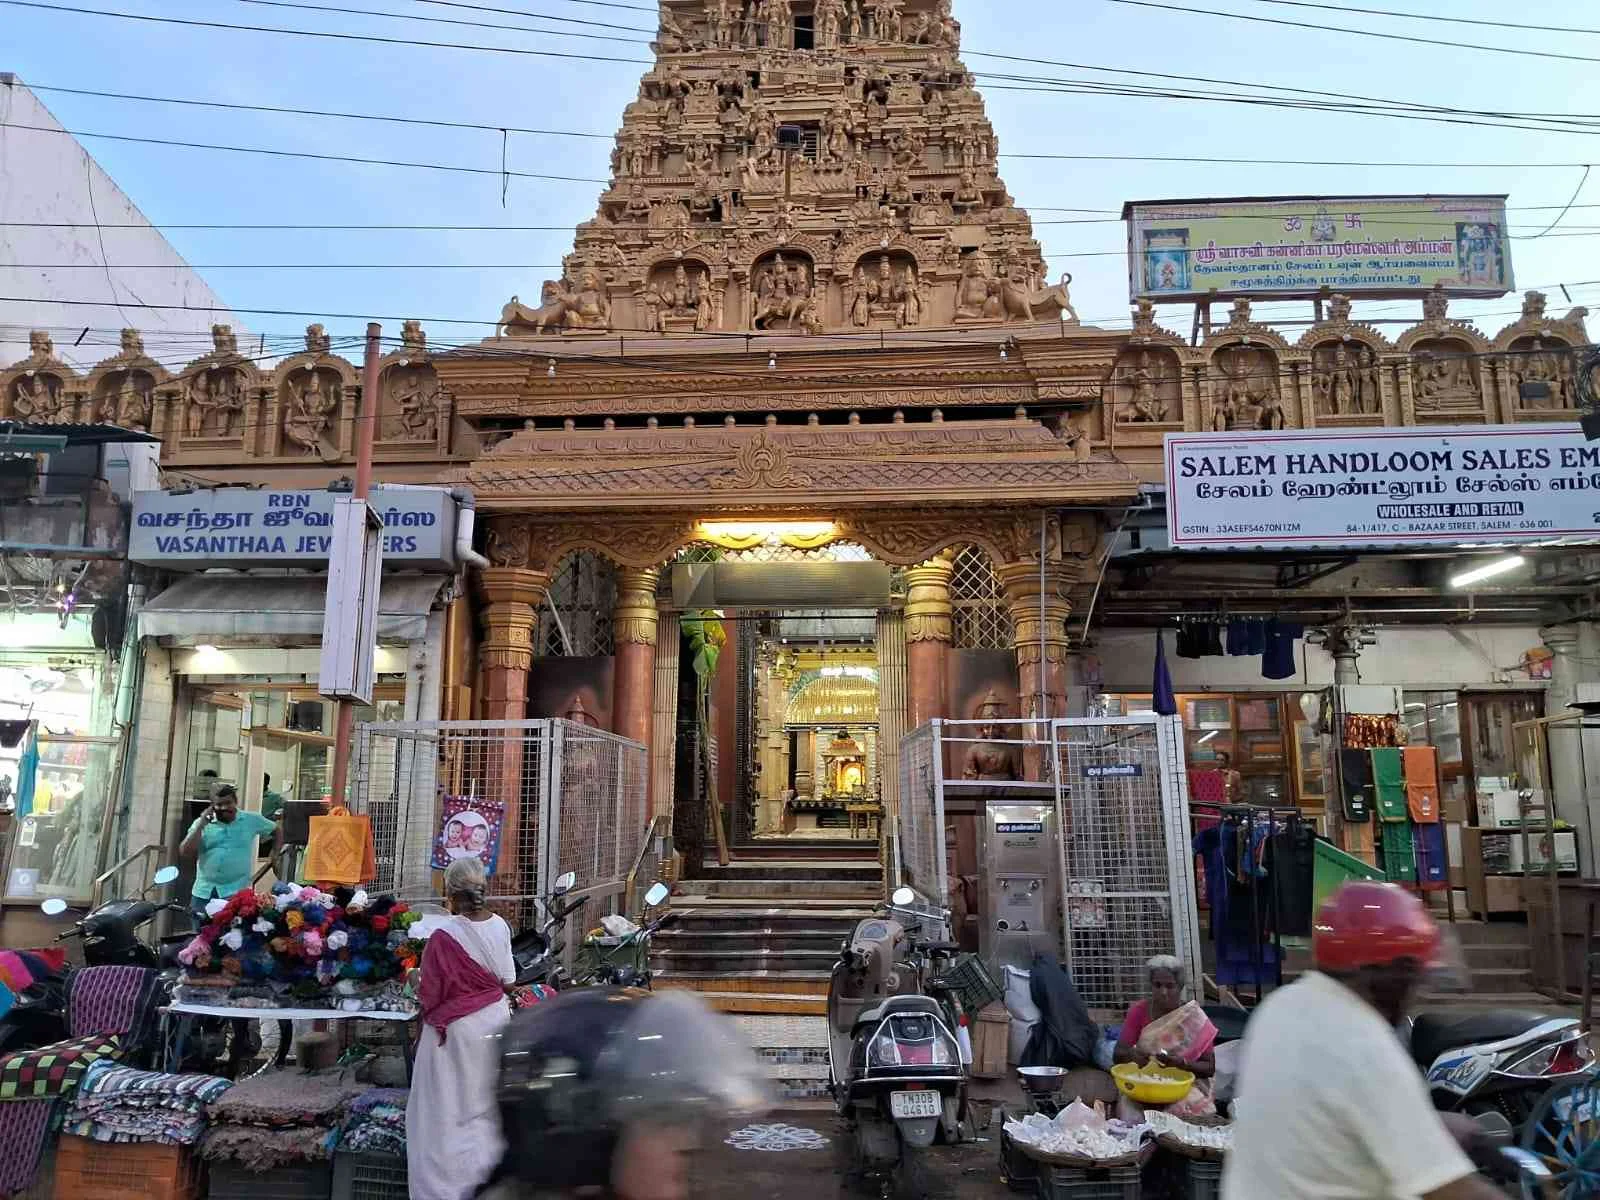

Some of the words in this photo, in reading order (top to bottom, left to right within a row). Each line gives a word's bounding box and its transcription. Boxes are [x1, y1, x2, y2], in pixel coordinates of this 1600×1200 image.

[1180, 455, 1276, 478] SALEM
[1286, 450, 1454, 475] HANDLOOM
[1461, 448, 1551, 471] SALES
[1196, 478, 1273, 498] சேலம்
[1282, 475, 1448, 501] ஹேண்ட்லூம்
[1455, 471, 1541, 493] சேல்ஸ்
[268, 494, 311, 508] RBN
[1378, 504, 1451, 519] WHOLESALE
[1453, 503, 1479, 517] AND
[1481, 502, 1523, 516] RETAIL
[137, 508, 253, 533] வசந்தா
[1408, 522, 1446, 531] BAZAAR
[1481, 520, 1511, 530] SALEM
[1519, 520, 1536, 529] 636
[1537, 519, 1553, 528] 001
[1182, 525, 1209, 534] GSTIN
[156, 535, 286, 553] VASANTHAA
[295, 535, 417, 553] JEWERS
